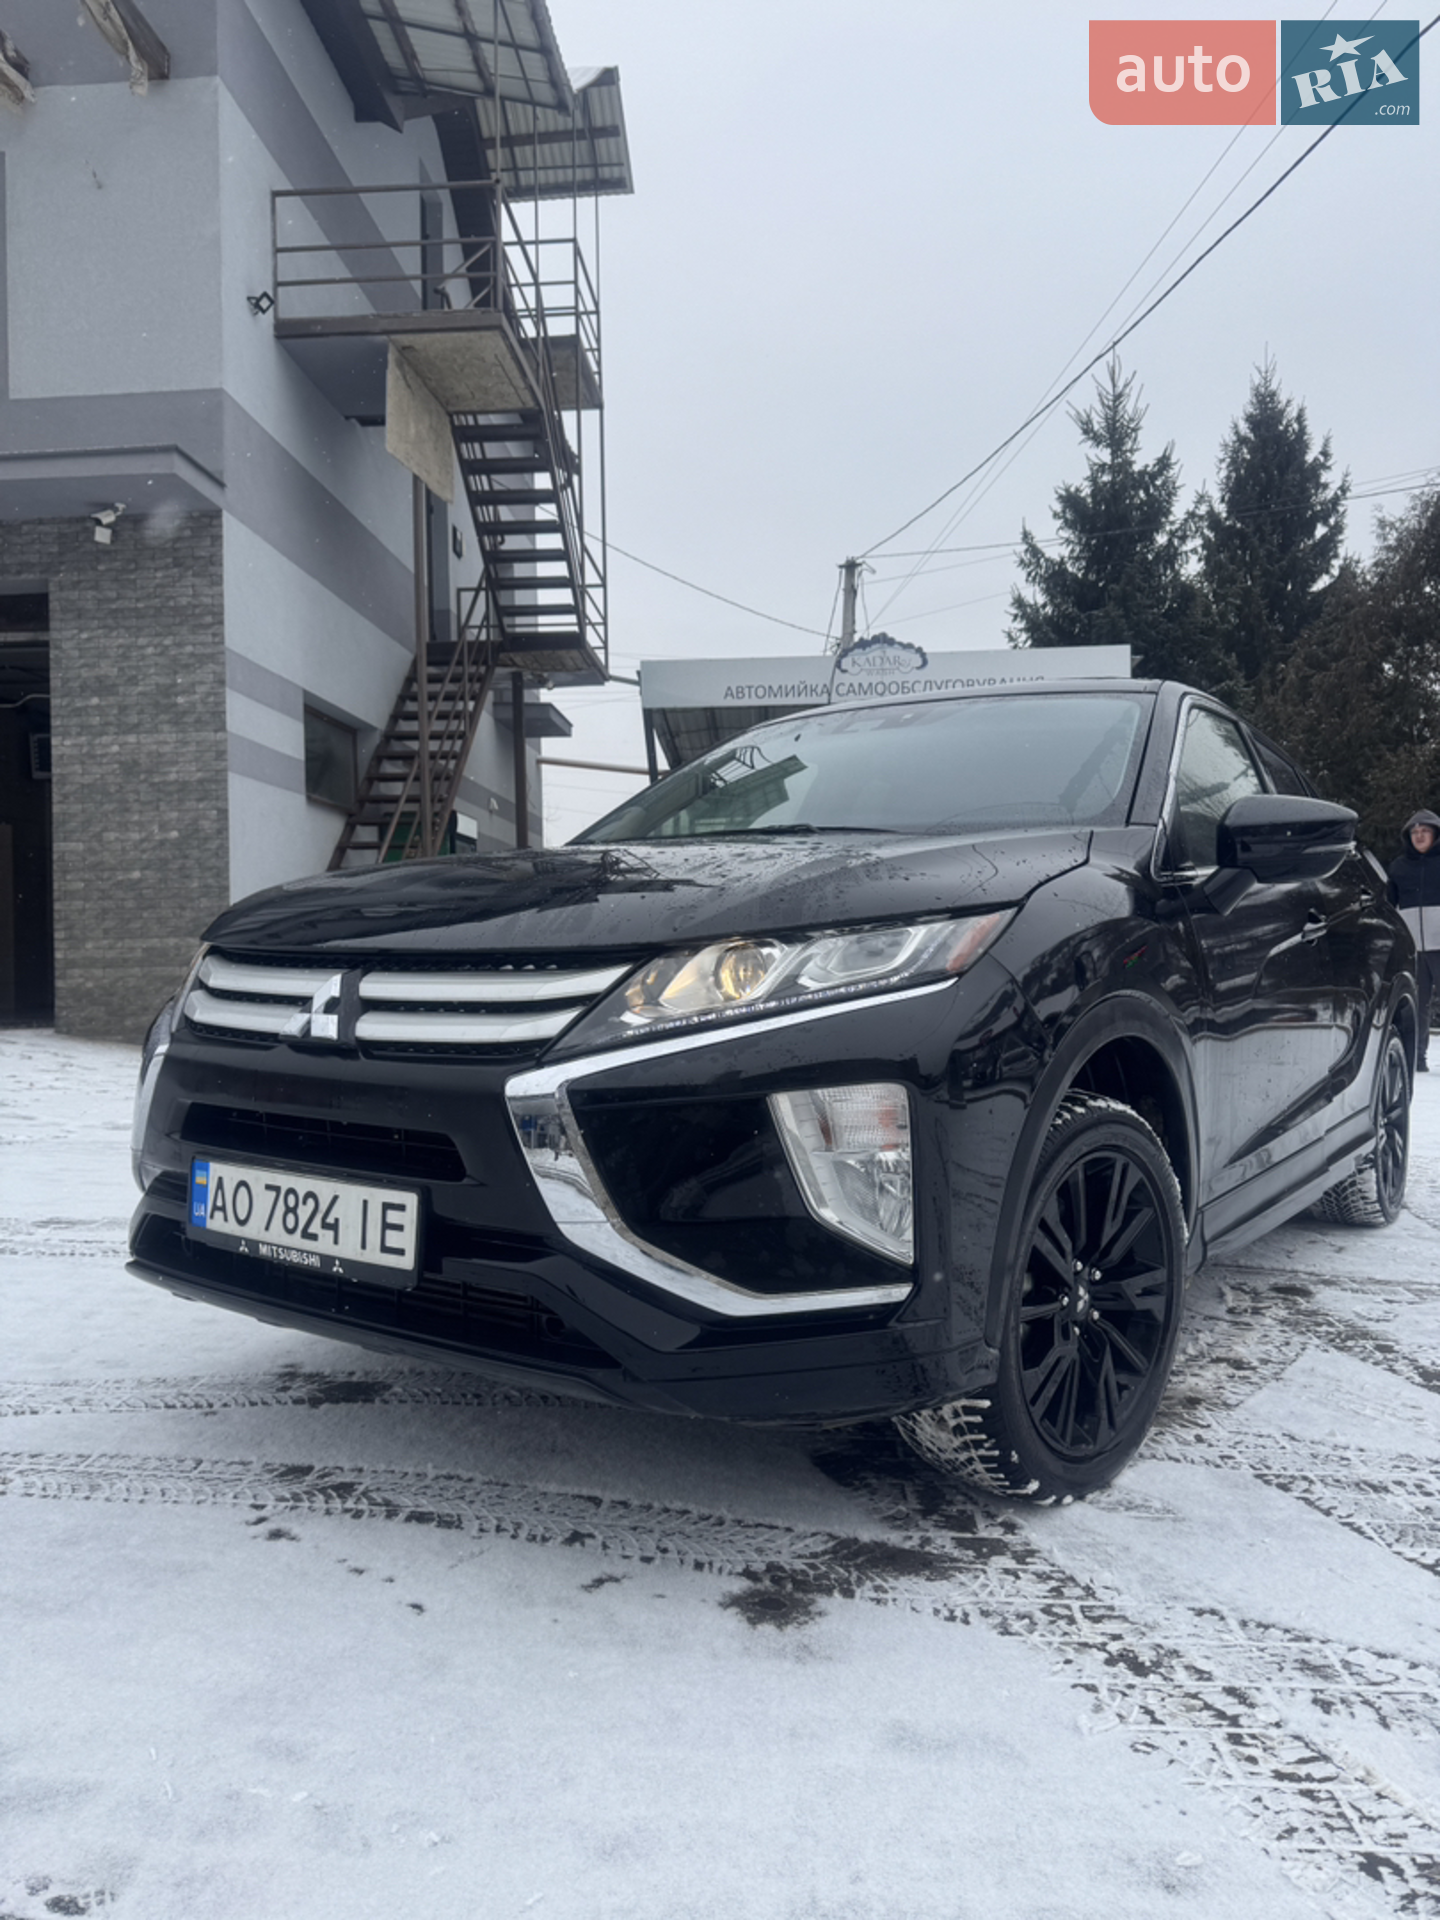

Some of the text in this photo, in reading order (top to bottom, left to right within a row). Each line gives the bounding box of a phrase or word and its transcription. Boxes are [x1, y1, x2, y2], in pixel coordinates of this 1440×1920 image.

[723, 680, 831, 700] АВТОМИЙКА
[193, 1201, 206, 1218] UA
[209, 1176, 407, 1257] AO 7824 IE
[258, 1243, 321, 1268] MITSUBISHI
